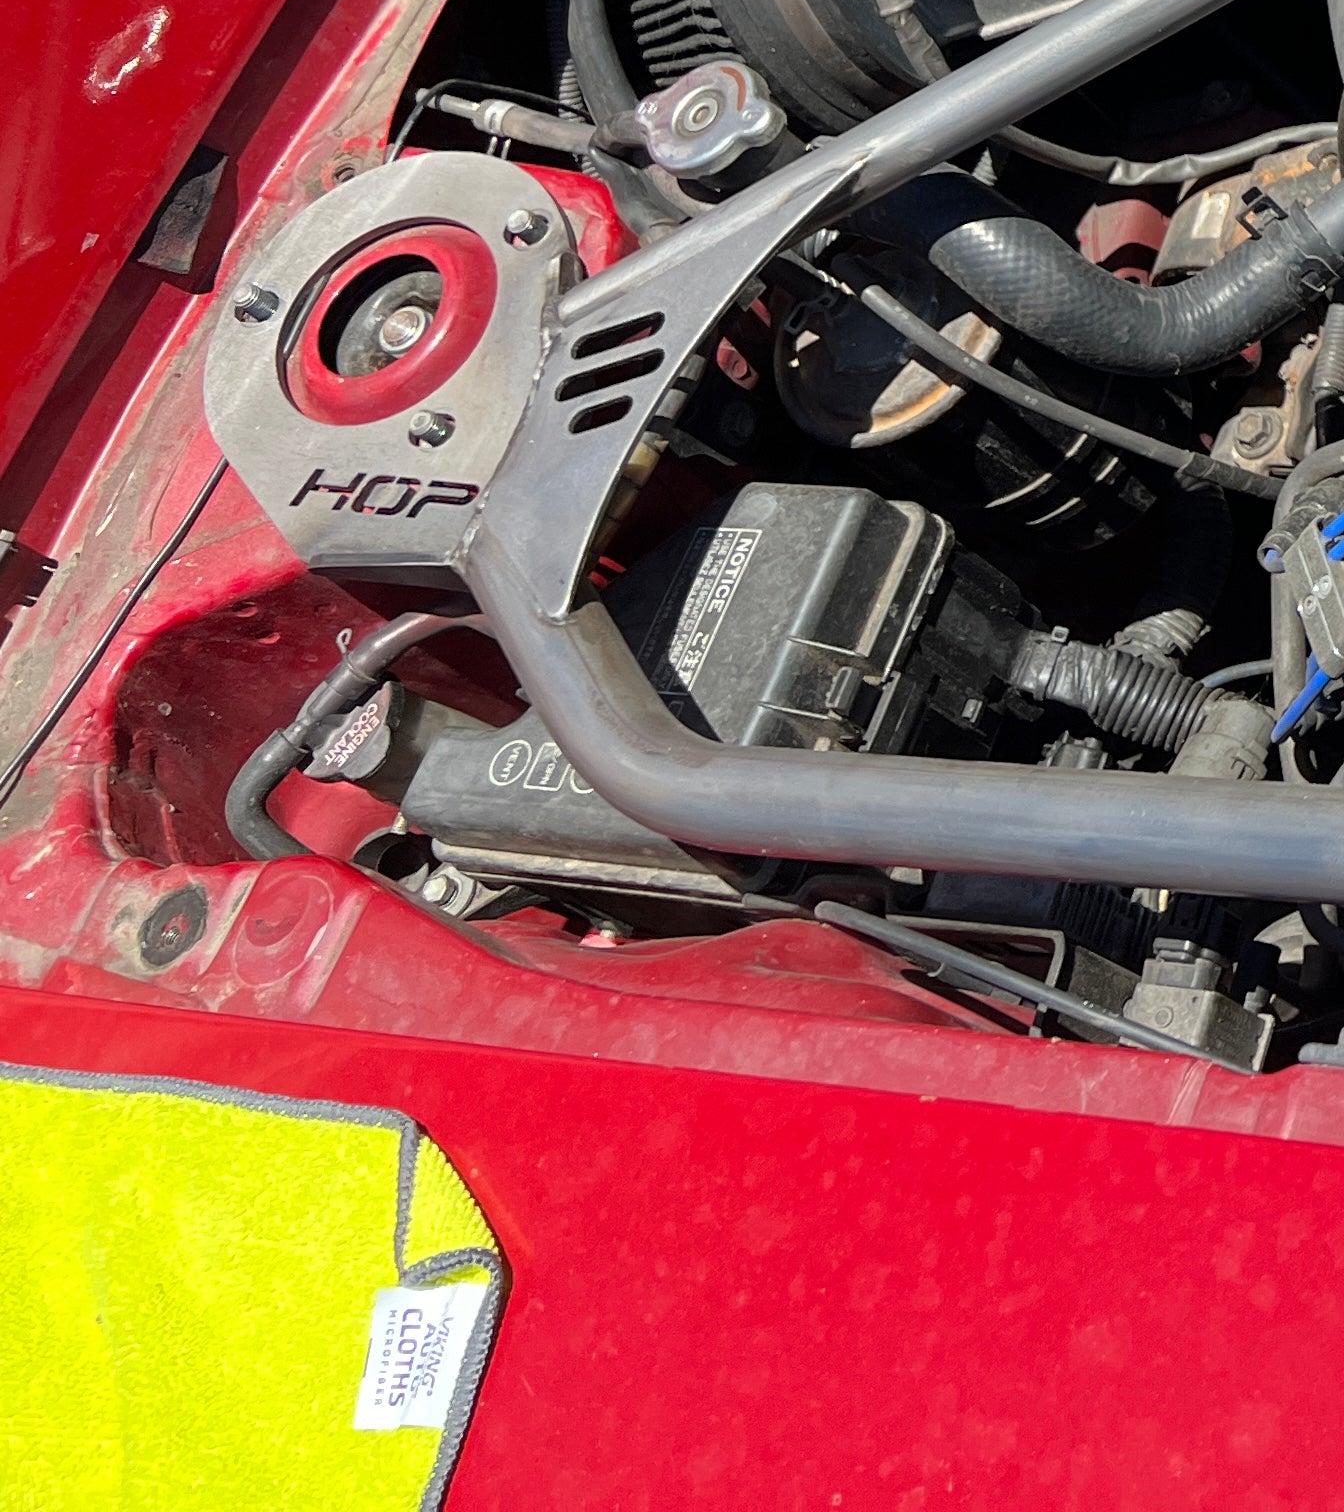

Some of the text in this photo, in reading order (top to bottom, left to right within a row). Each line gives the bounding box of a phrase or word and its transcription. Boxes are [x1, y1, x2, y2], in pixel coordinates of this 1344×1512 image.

[707, 538, 753, 614] NOTICE
[324, 703, 379, 766] COOLANT
[334, 715, 381, 768] ENGINE
[500, 746, 523, 781] VENT
[373, 1310, 399, 1407] MICROFIBER
[388, 1307, 424, 1408] CLOTHS
